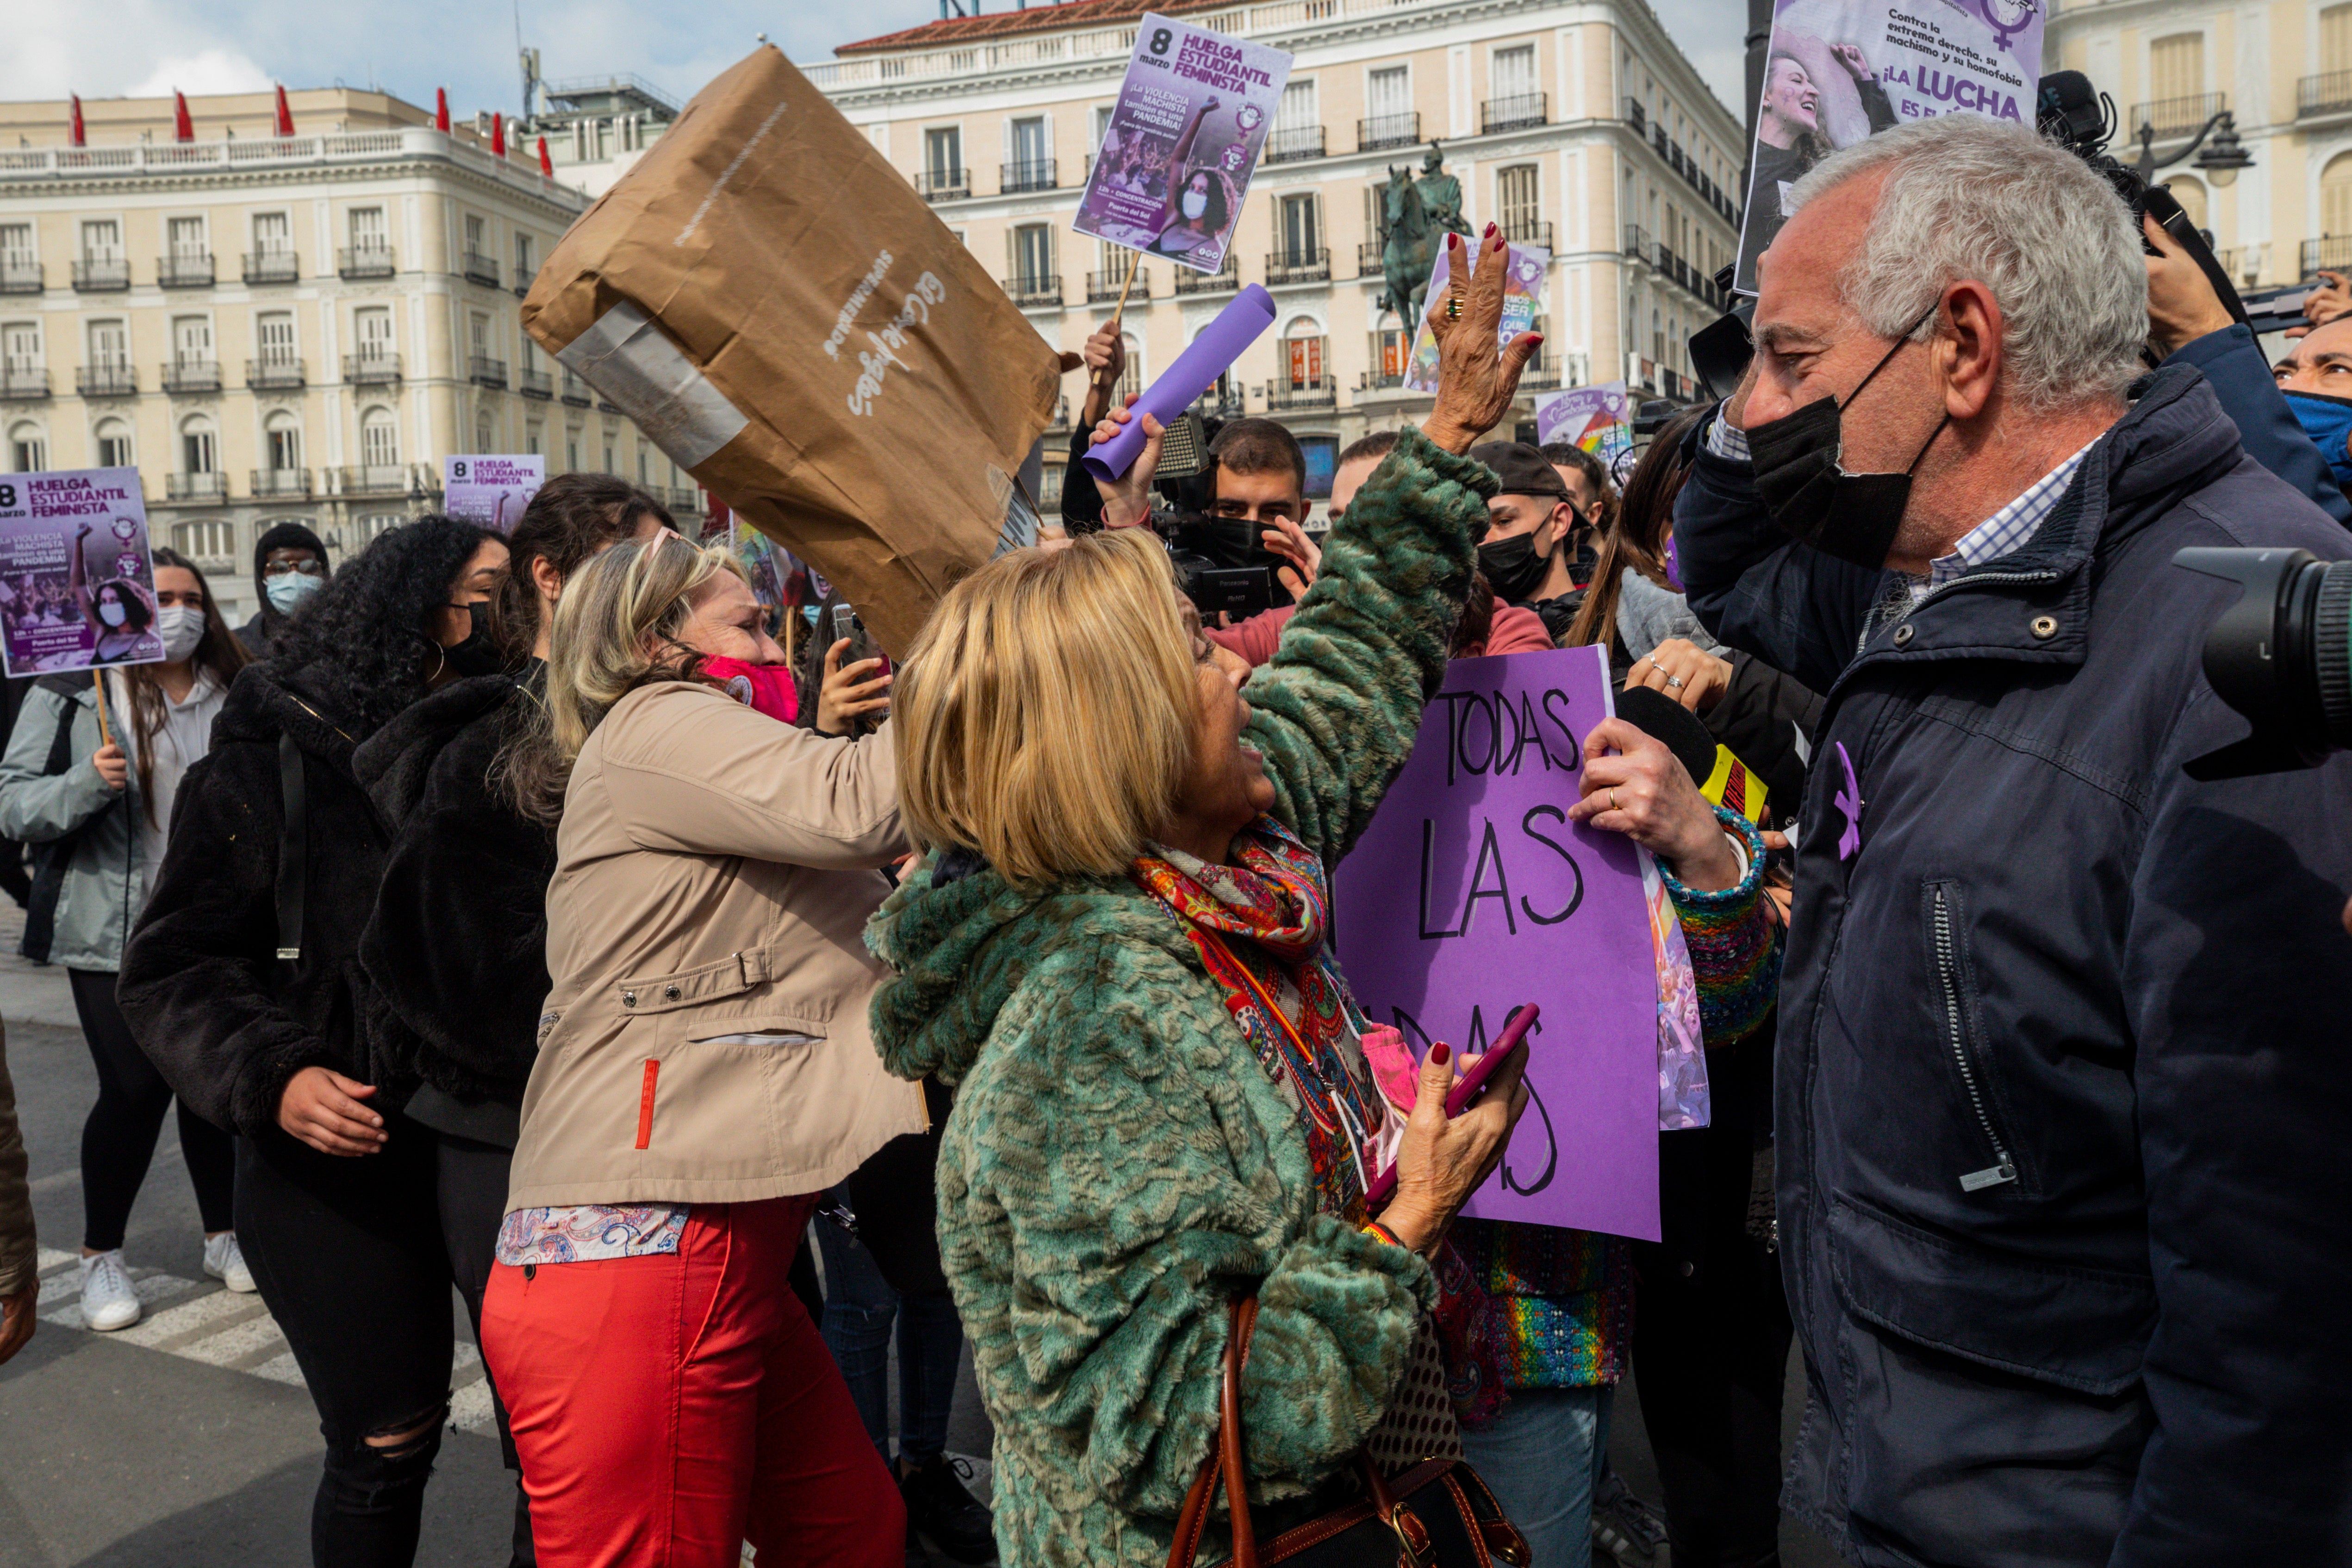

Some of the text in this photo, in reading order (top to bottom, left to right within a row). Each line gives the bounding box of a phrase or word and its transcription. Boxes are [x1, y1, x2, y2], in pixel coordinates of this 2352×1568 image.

[1888, 9, 1940, 34] Contra la
[1150, 28, 1172, 55] 8
[1182, 33, 1242, 63] HUELGA
[1888, 23, 1997, 67] extrema derecha, su
[1139, 54, 1170, 69] marzo
[1178, 48, 1271, 87] ESTUDIANTIL
[1886, 34, 2022, 87] machismo y su homofobia
[1173, 61, 1245, 95] FEMINISTA
[1142, 95, 1186, 114] MACHISTA
[1145, 86, 1189, 106] VIOLENCIA
[1883, 65, 1911, 87] ¡LA
[1916, 64, 2022, 124] LUCHA
[1125, 99, 1157, 114] también
[1168, 113, 1183, 123] una
[1901, 99, 1919, 118] ES
[1132, 110, 1182, 131] PANDEMIA!
[454, 462, 466, 477] 8
[473, 460, 513, 468] HUELGA
[473, 469, 535, 478] ESTUDIANTIL
[27, 477, 92, 492] HUELGA
[474, 477, 523, 485] FEMINISTA
[0, 484, 17, 507] 8
[30, 488, 128, 505] ESTUDIANTIL
[32, 502, 110, 518] FEMINISTA
[1434, 688, 1579, 787] TODAS
[1418, 803, 1584, 940] LAS
[643, 1067, 654, 1110] PRADA
